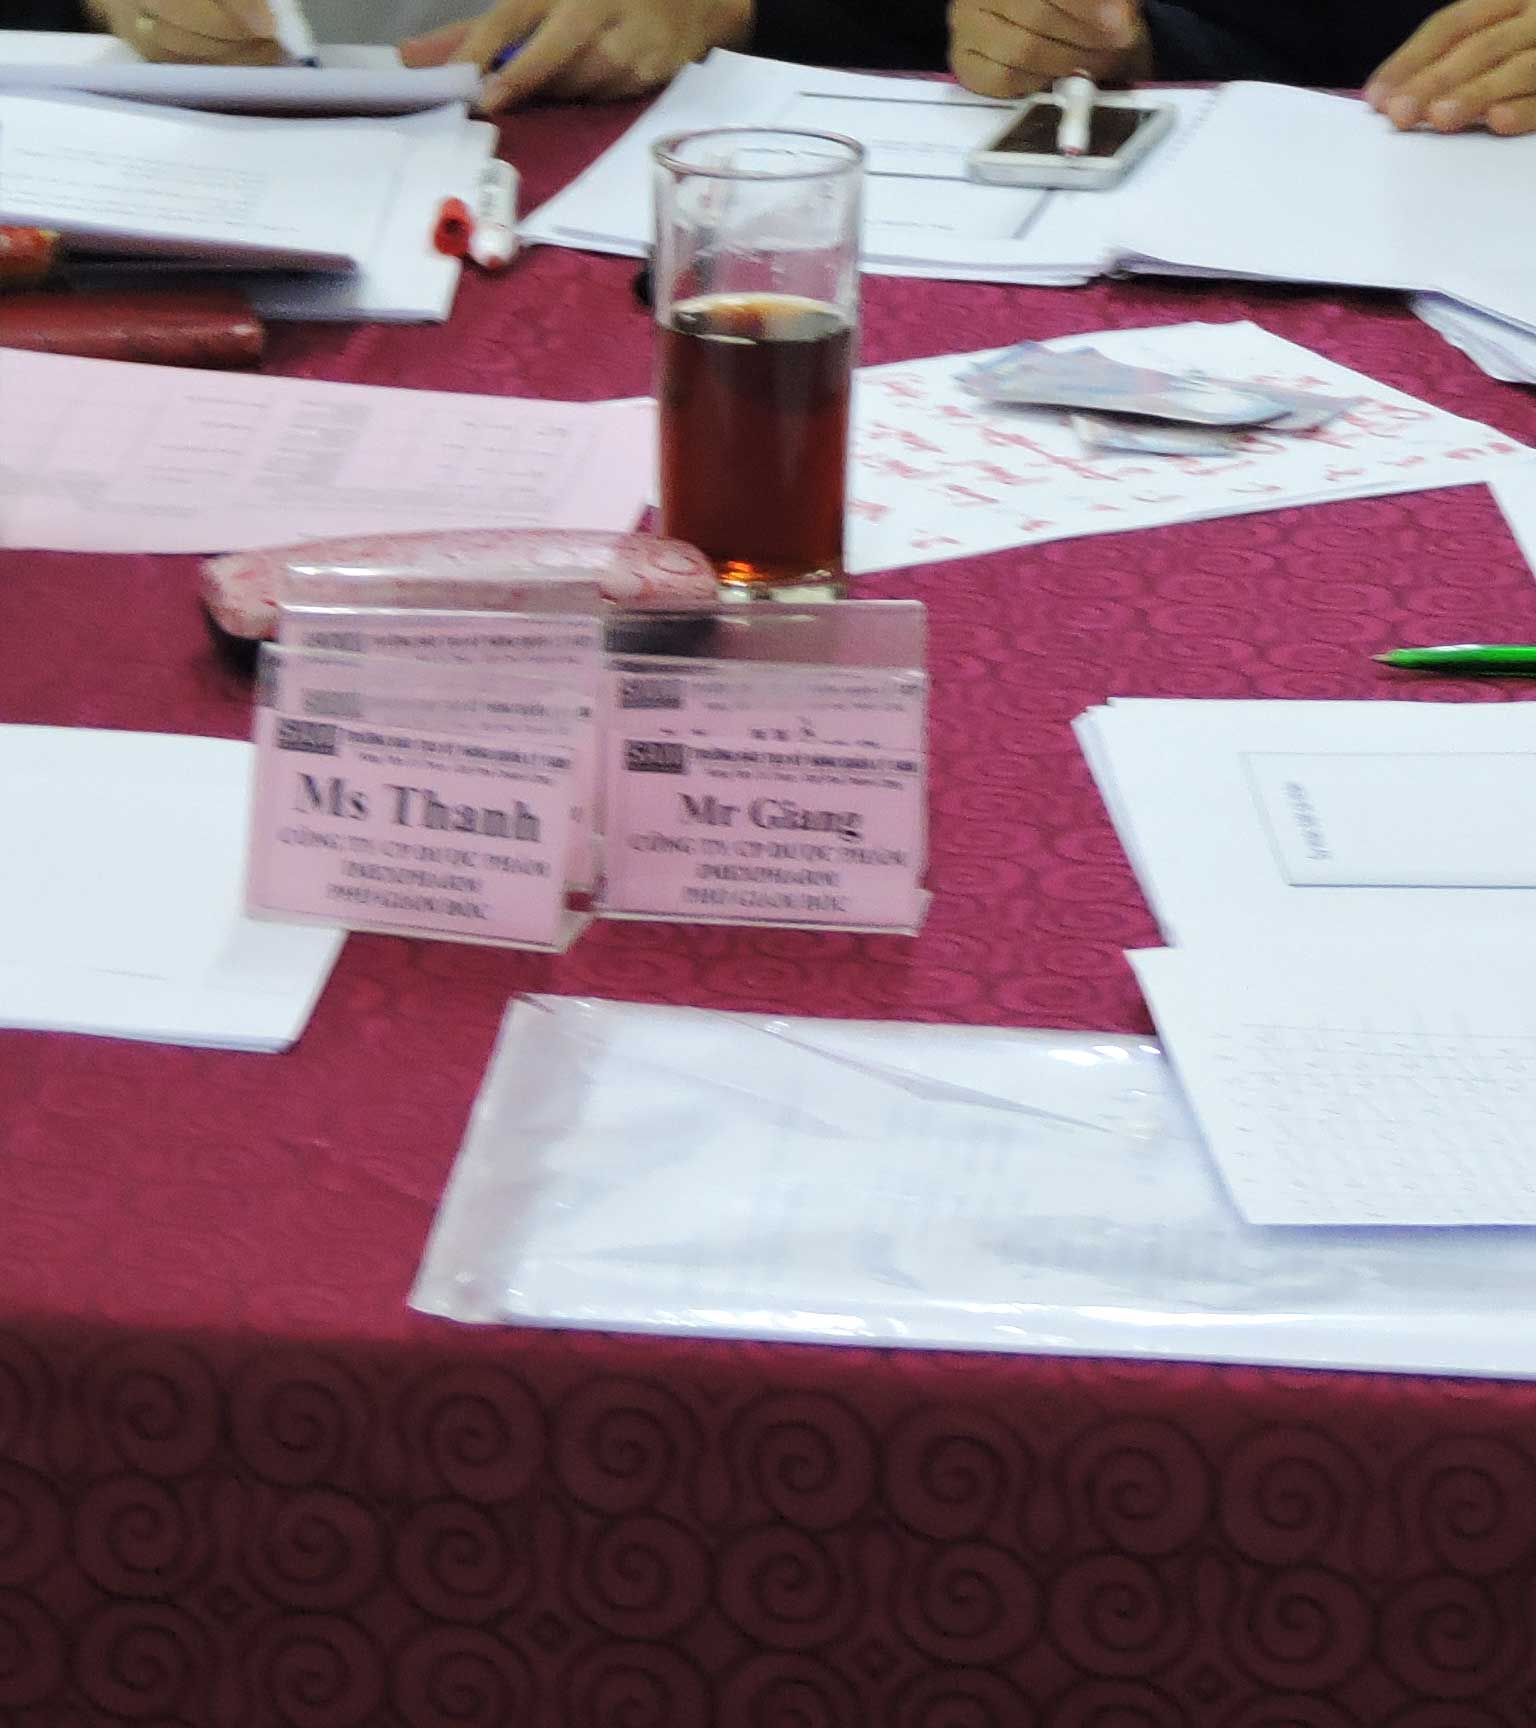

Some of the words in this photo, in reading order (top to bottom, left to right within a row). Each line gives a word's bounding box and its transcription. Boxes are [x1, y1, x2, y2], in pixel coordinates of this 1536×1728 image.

[292, 771, 369, 821] Ms
[382, 783, 541, 843] Thanh
[676, 791, 741, 828] Mr
